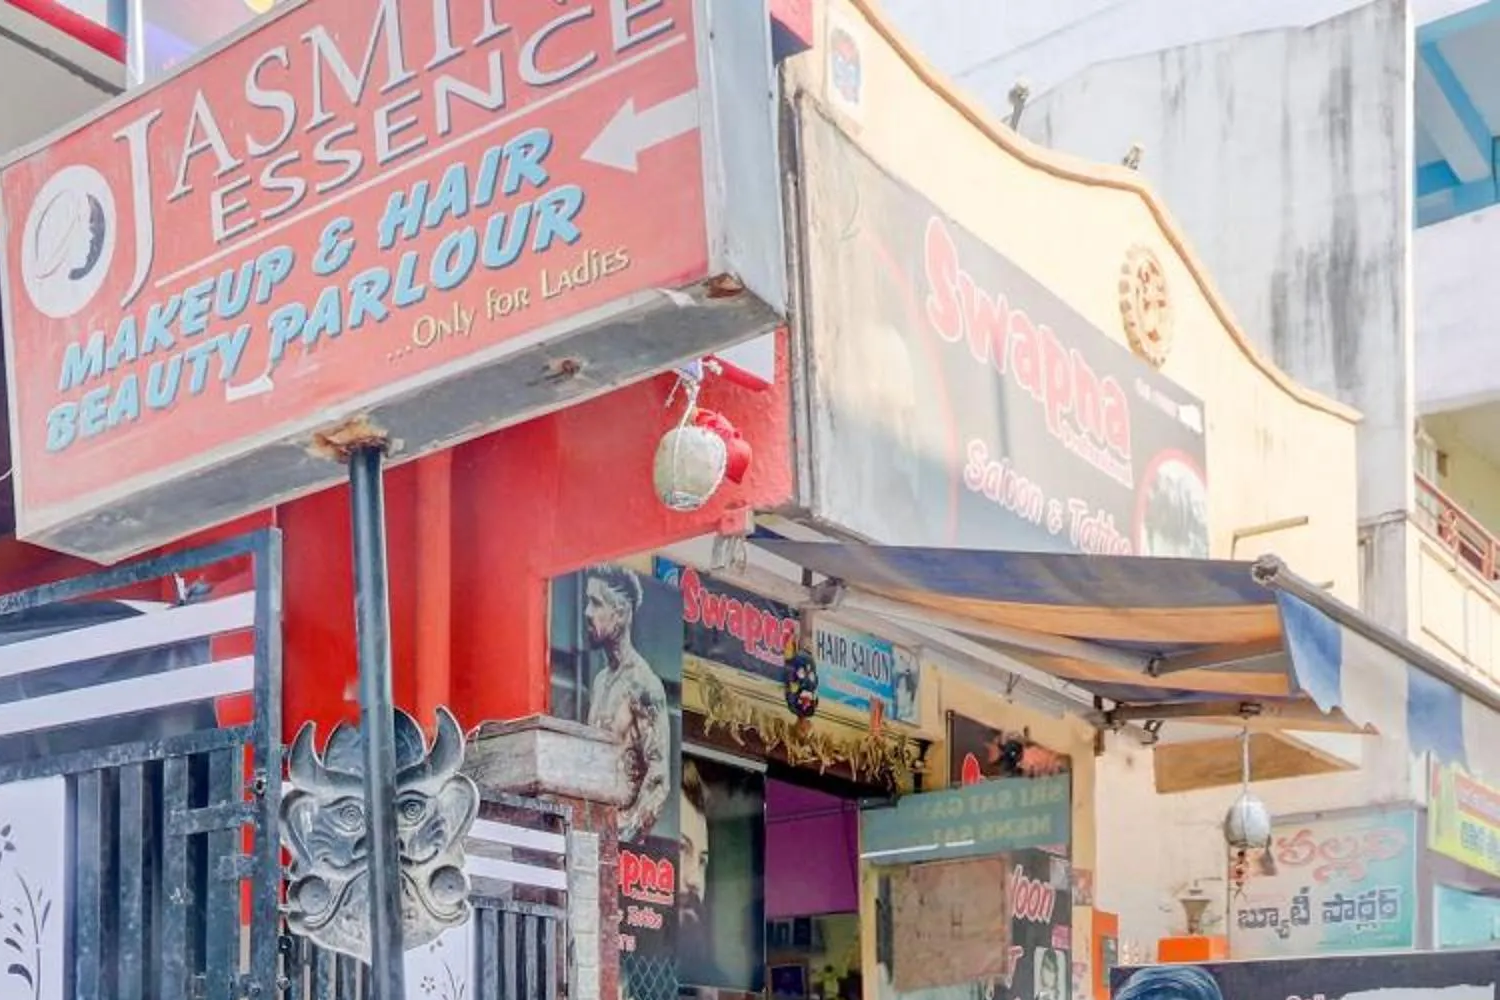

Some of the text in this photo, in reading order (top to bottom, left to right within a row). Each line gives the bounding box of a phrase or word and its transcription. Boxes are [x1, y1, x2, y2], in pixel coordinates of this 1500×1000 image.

[113, 0, 566, 307] JASMI
[211, 0, 675, 243] ESSENCE
[45, 186, 583, 453] BEAUTY PARLOUR
[58, 128, 553, 392] MAKEUP & HAIR
[924, 215, 1132, 460] Swapna
[964, 438, 1043, 526] Saloon
[680, 567, 799, 655] Swapna
[816, 630, 848, 669] HAIR
[852, 641, 893, 683] SALON
[617, 850, 674, 896] pna
